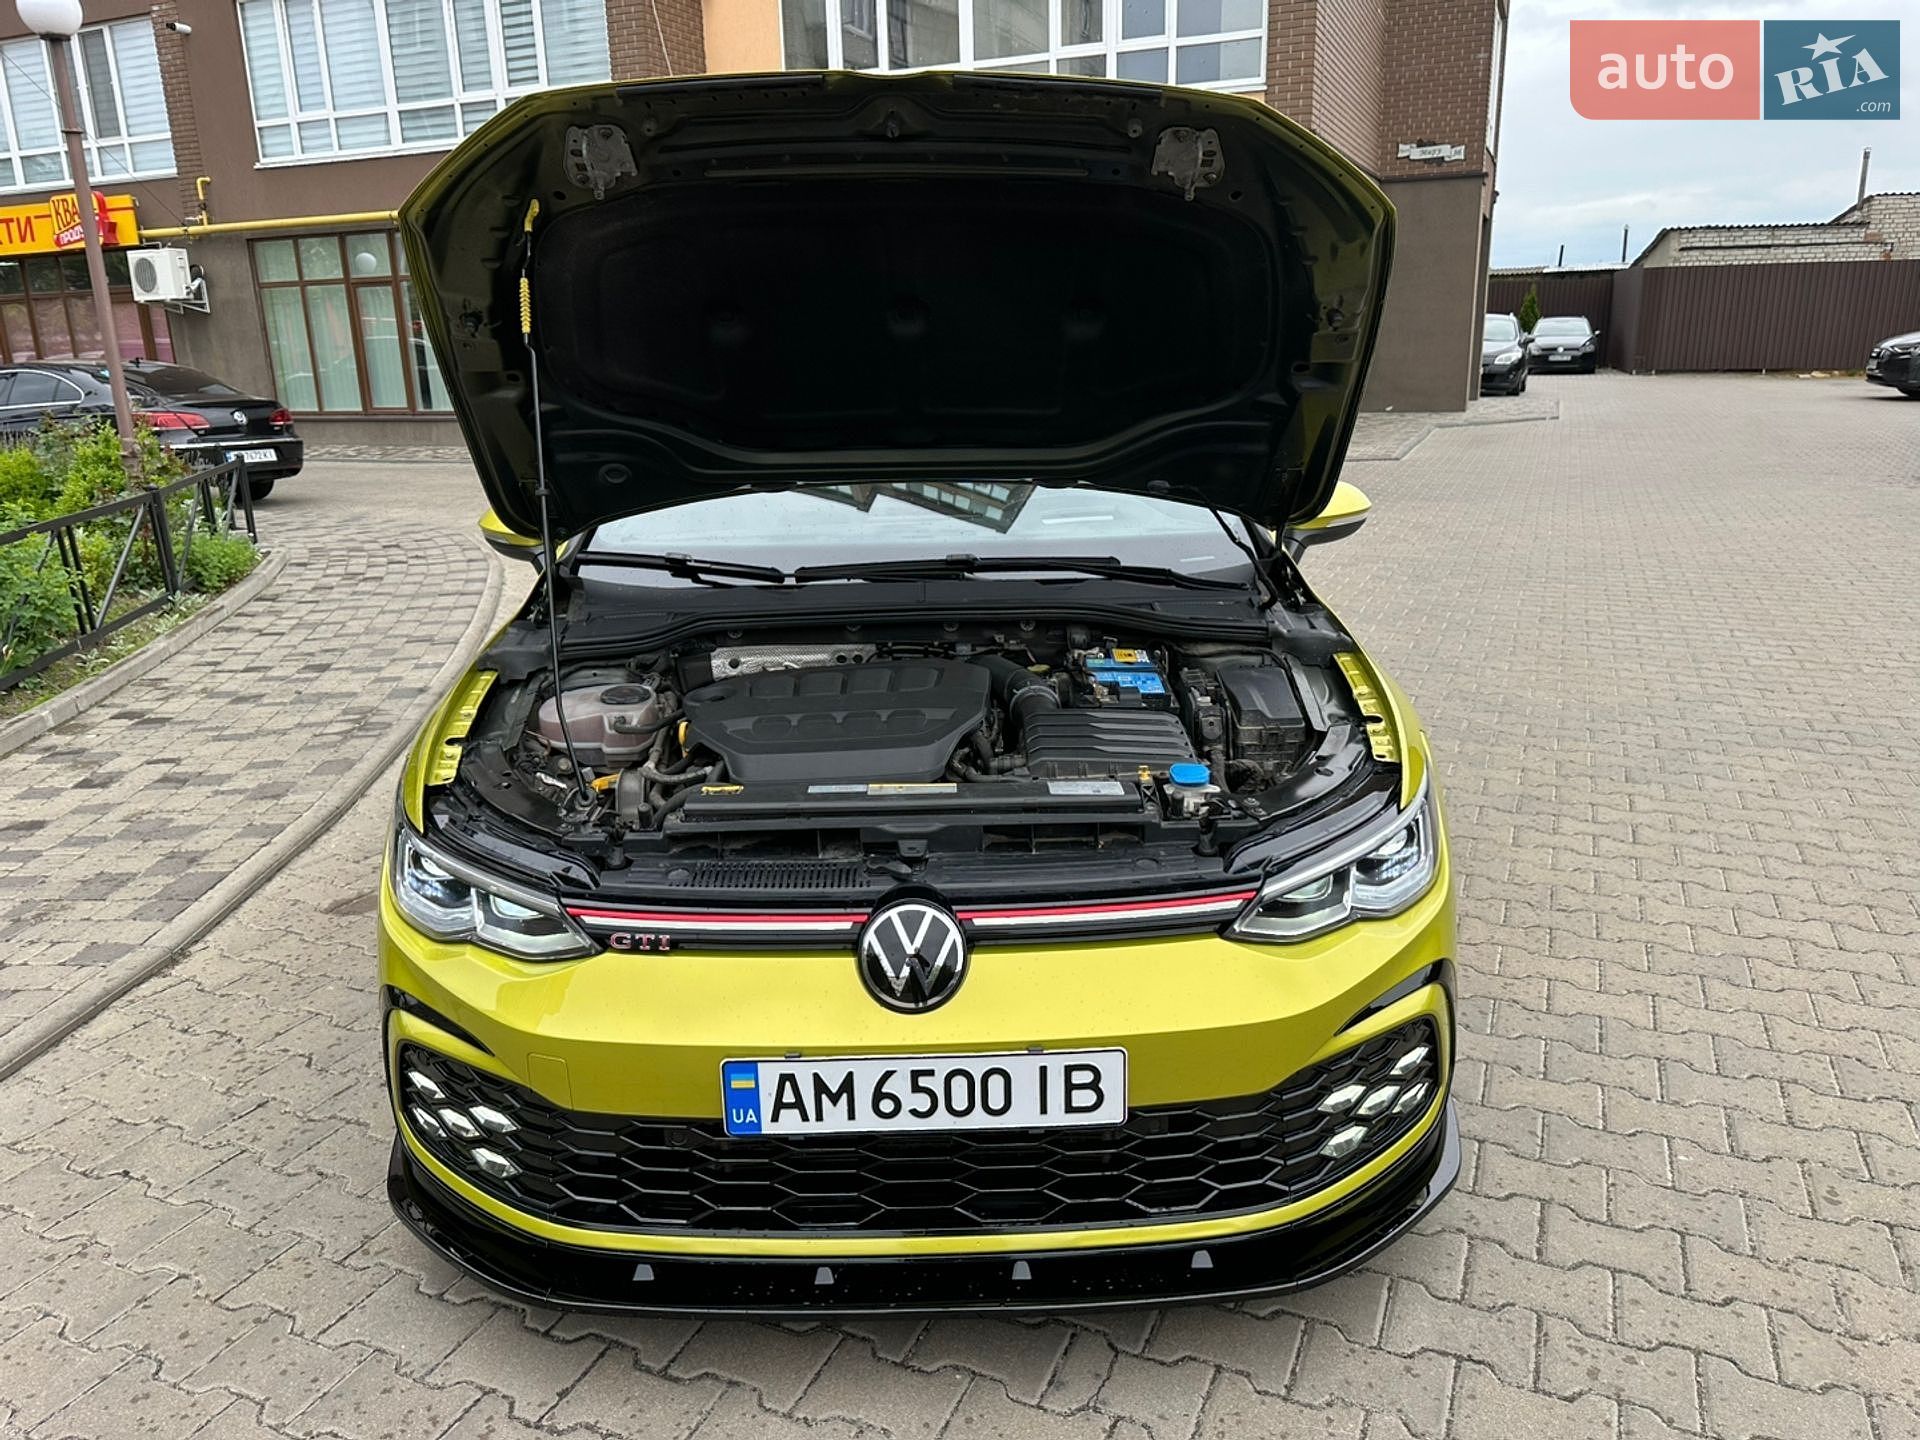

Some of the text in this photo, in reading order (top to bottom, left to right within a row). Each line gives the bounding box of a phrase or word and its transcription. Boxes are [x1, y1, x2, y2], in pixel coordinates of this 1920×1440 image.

[51, 196, 80, 231] КВА
[0, 216, 36, 245] ТИ
[609, 932, 671, 952] GTI
[770, 1063, 1105, 1123] AM 6500 IB
[732, 1108, 757, 1124] UA
